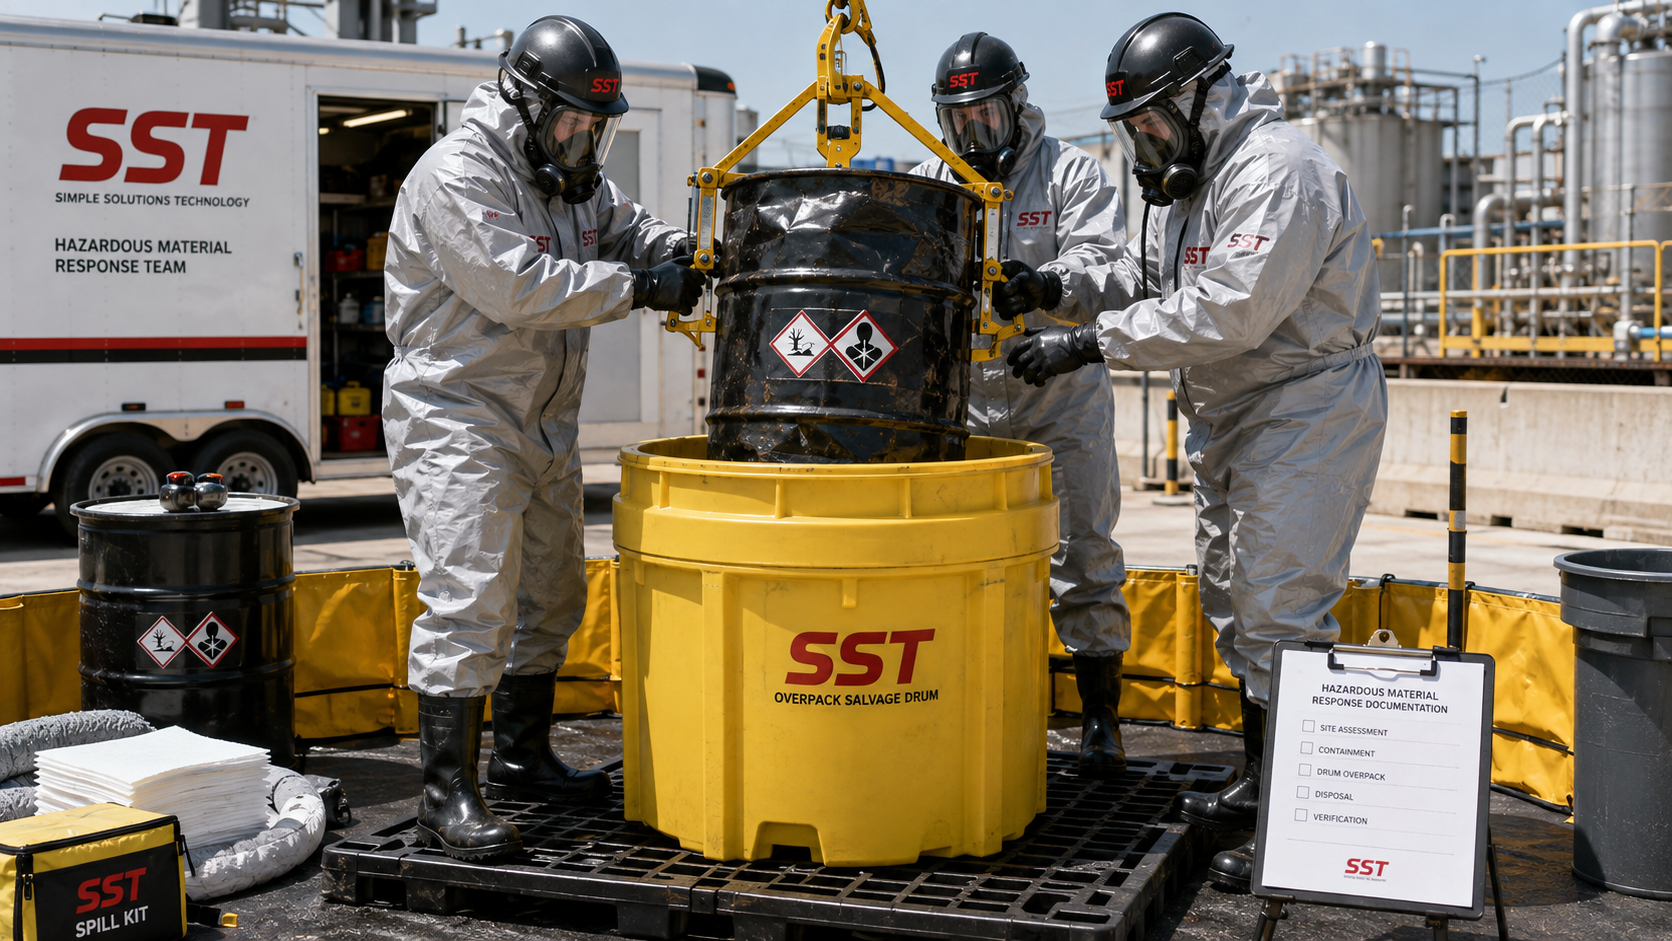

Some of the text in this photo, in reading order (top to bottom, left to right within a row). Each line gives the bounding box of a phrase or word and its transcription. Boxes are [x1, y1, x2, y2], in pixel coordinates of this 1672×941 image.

[590, 78, 620, 93] SST
[949, 71, 979, 88] SST
[59, 107, 249, 186] SST
[55, 192, 250, 208] SIMPLE SOLUTIONS TECHNOLOGY
[1016, 211, 1052, 227] SST
[55, 238, 232, 254] HAZARDOUS MATERIAL
[582, 229, 598, 247] SST
[1227, 233, 1270, 251] SST
[1184, 246, 1211, 265] SST
[55, 259, 187, 274] RESPONSE TEAM
[785, 628, 935, 686] SST
[774, 689, 939, 706] OVERPACK SALVAGE DRUM
[1321, 683, 1439, 701] HAZARDOUS MATERIAL
[1312, 696, 1448, 714] RESPONSE DOCUMENTATION
[1320, 724, 1388, 737] SITE ASSESSMENT
[1318, 746, 1376, 757] CONTAINMENT
[1317, 768, 1386, 781] DRUM OVERPACK
[1315, 790, 1354, 801] DISPOSAL
[1313, 813, 1368, 825] VERIFICATION
[1344, 858, 1390, 877] SST
[75, 867, 147, 915] SST
[75, 905, 148, 938] SPILL KIT
